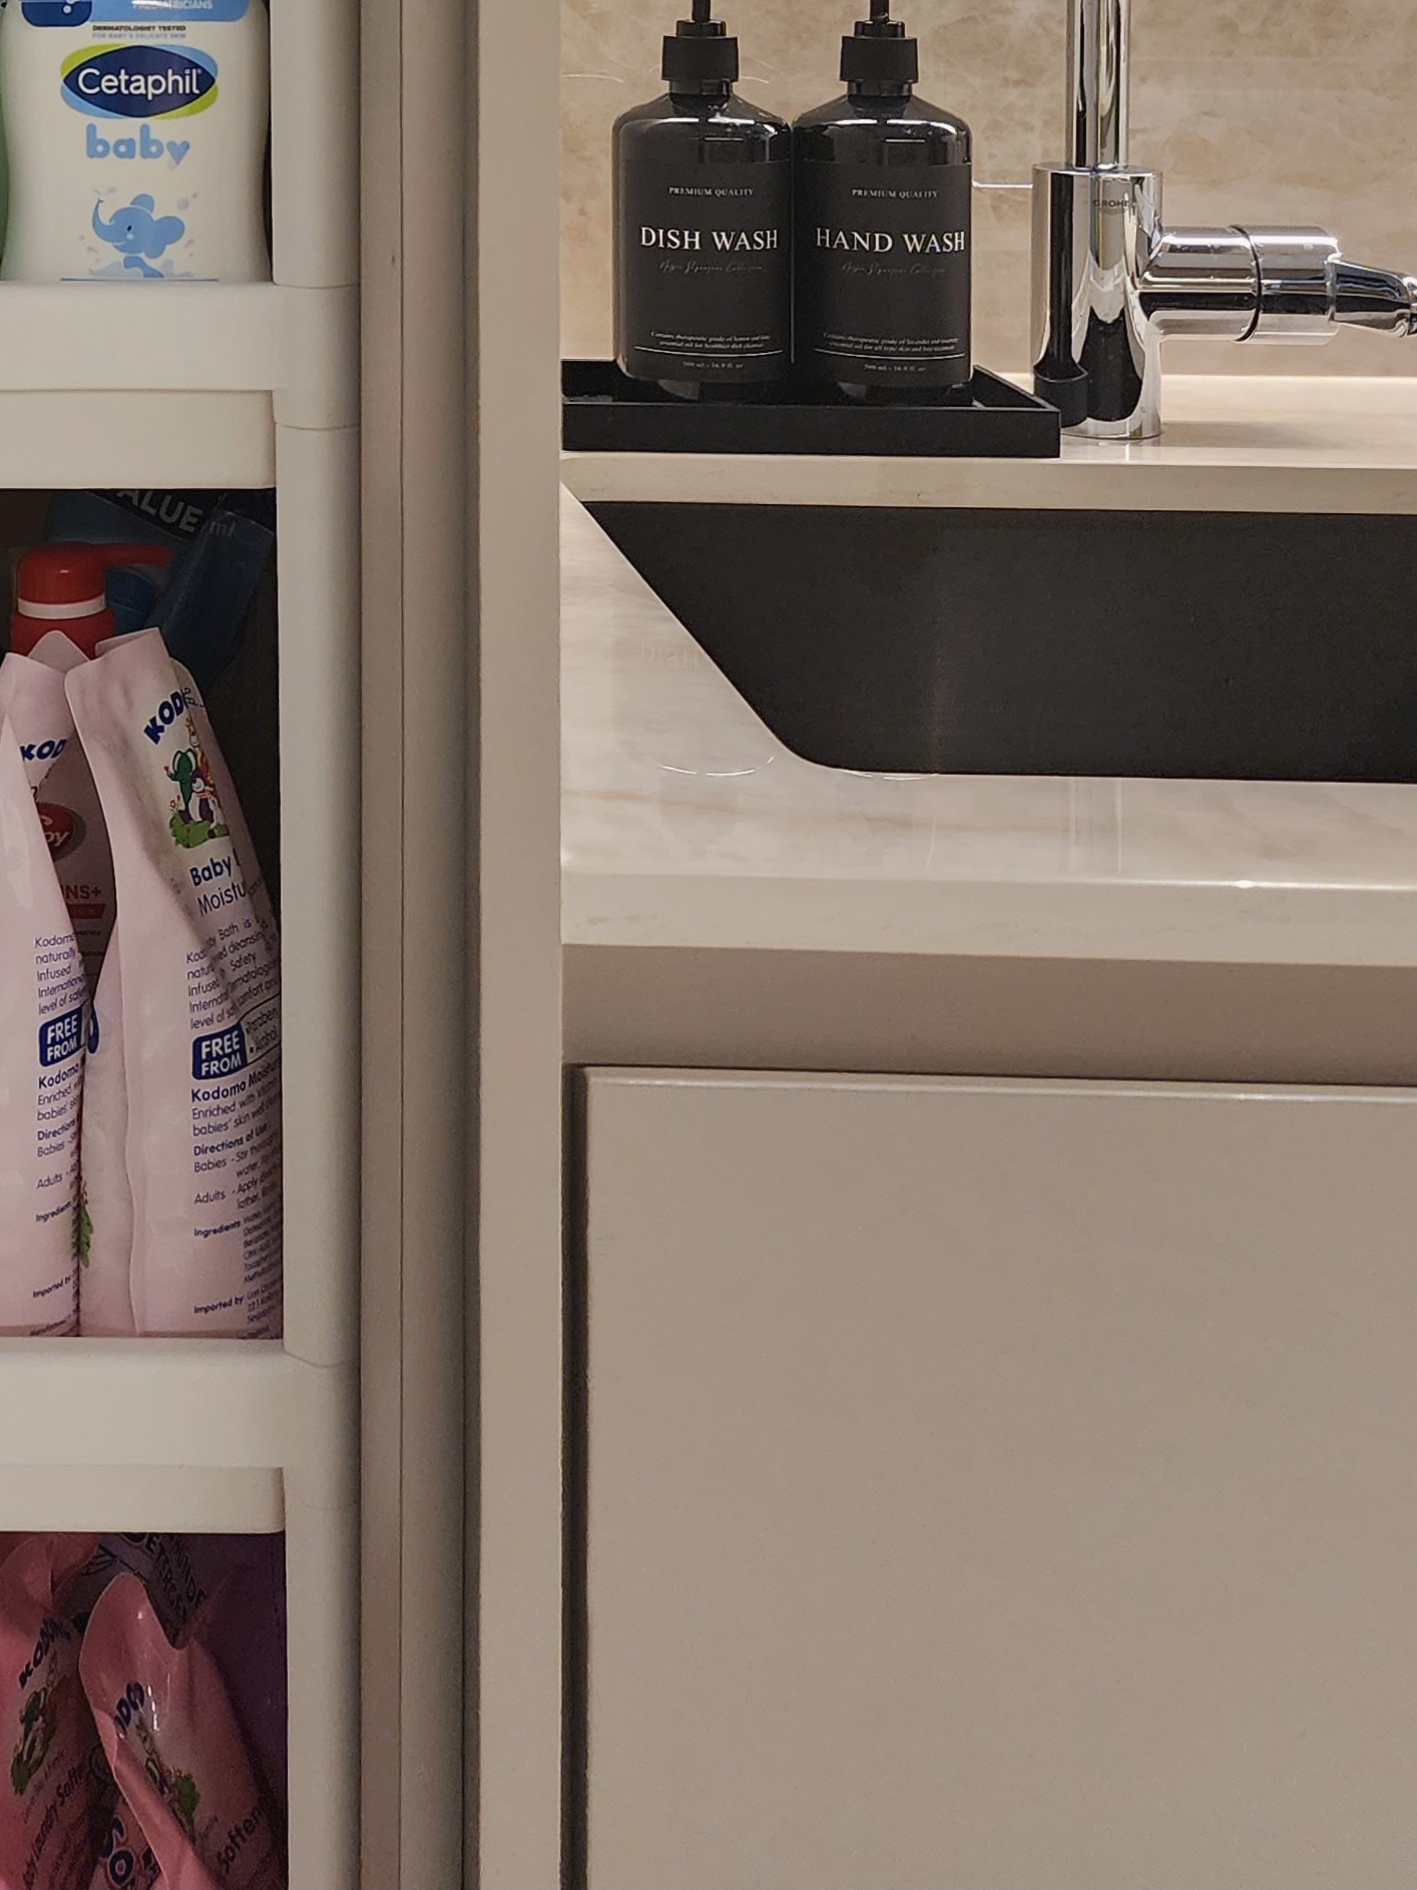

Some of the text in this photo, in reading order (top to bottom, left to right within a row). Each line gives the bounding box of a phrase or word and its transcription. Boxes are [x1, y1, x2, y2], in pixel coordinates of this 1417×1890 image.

[92, 24, 186, 32] DERMATOLOGIST TESTED
[78, 68, 201, 100] Cetaphil
[86, 123, 190, 166] baby
[668, 186, 754, 197] PREMIUM QUALITY
[851, 188, 938, 199] PREMIUM QUALITY
[640, 226, 778, 251] DISH WASH
[816, 227, 965, 253] HAND WASH
[116, 490, 203, 533] ALUE
[143, 689, 185, 746] KOD
[19, 738, 67, 762] KOD
[190, 856, 232, 887] Baby
[197, 879, 247, 917] Moistu
[36, 963, 72, 982] Infused
[38, 998, 58, 1016] level
[46, 1014, 79, 1045] FREE
[46, 1035, 78, 1062] FROM
[200, 1030, 241, 1060] FREE
[38, 1062, 80, 1090] Kodomo
[200, 1052, 242, 1077] FROM
[37, 1083, 73, 1107] Enriched
[191, 1080, 247, 1103] Kodomo
[192, 1101, 237, 1120] Enriched
[37, 1140, 66, 1158] Babies
[193, 1137, 244, 1157] Directions
[193, 1157, 227, 1173] Babies
[36, 1172, 63, 1190] Adults
[193, 1190, 226, 1205] Adults
[32, 1278, 64, 1299] Imported
[193, 1296, 233, 1315] Imported
[216, 1805, 265, 1875] Soften
